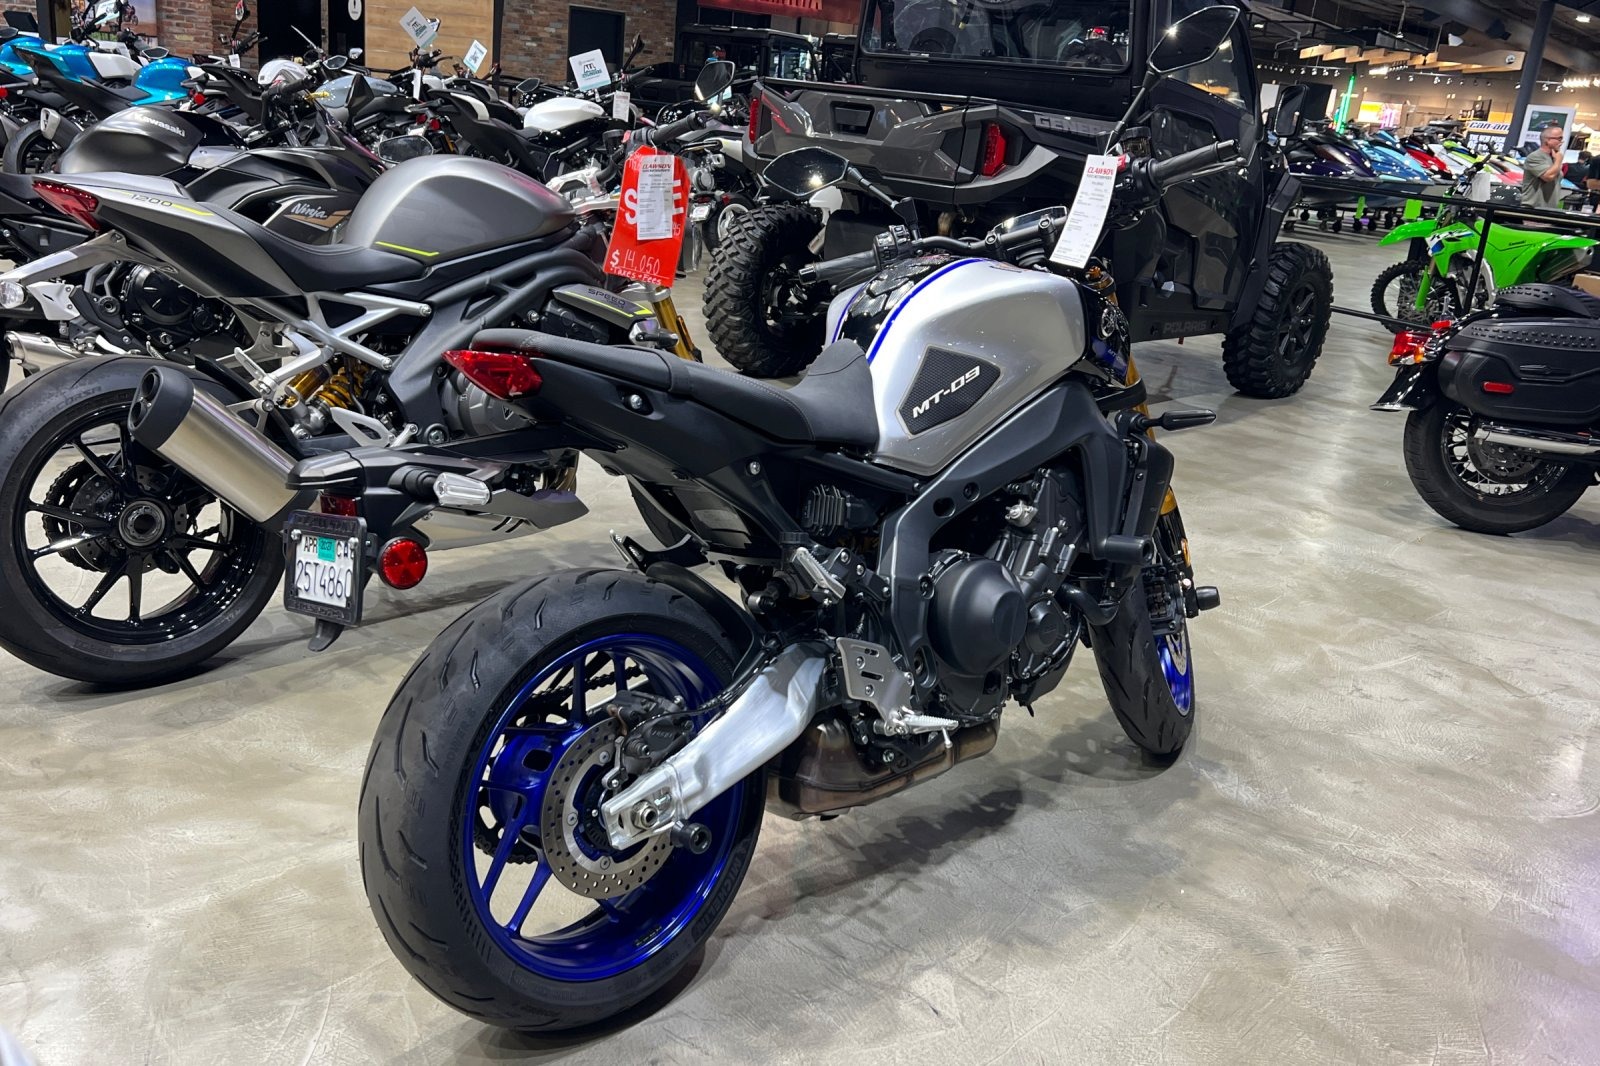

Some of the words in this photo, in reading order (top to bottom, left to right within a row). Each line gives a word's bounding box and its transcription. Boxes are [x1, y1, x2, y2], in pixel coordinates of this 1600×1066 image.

[135, 113, 186, 137] Kawasaki
[132, 194, 173, 207] 1200
[291, 202, 327, 218] Ninja
[588, 288, 626, 307] SPEED
[912, 365, 980, 418] MT-09
[304, 536, 318, 553] APR
[295, 560, 353, 598] 25T4860
